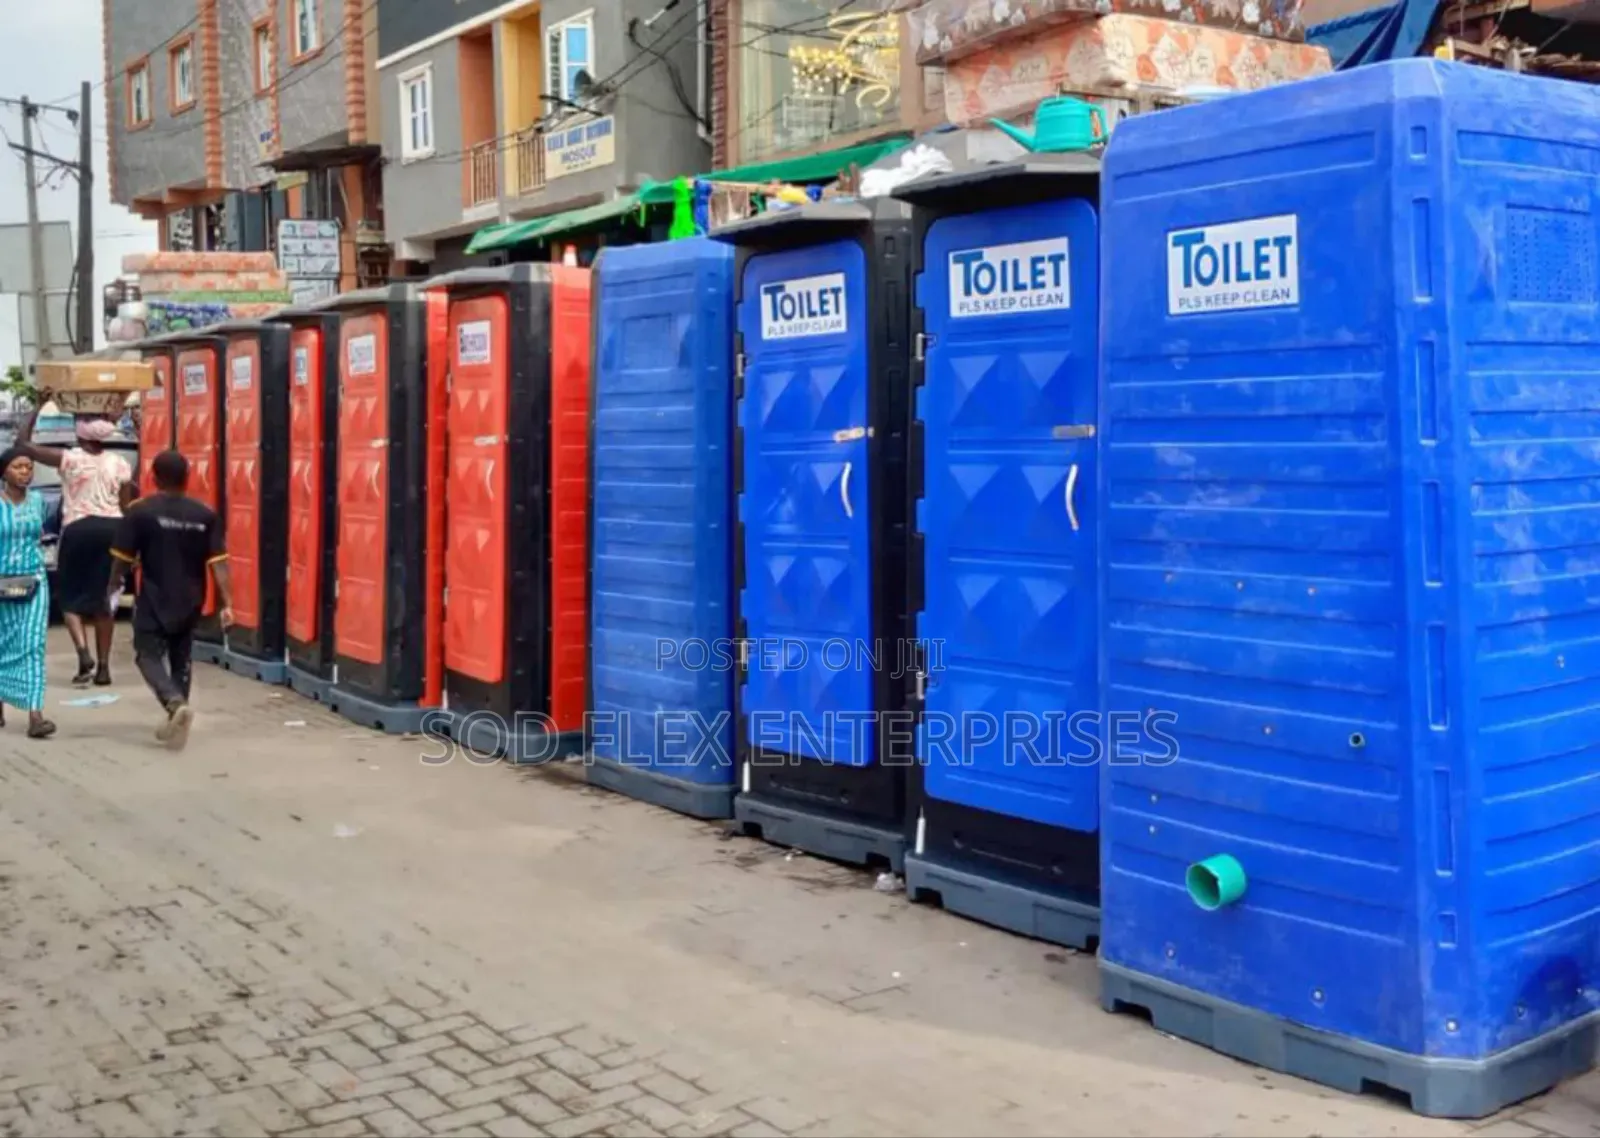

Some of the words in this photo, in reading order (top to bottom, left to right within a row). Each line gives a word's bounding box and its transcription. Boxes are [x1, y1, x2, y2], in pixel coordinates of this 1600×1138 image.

[952, 250, 1066, 297] TOILET
[1172, 231, 1292, 288] TOILET
[763, 284, 842, 322] TOILET
[958, 301, 981, 313] PLS
[983, 297, 1017, 311] KEEP
[1019, 292, 1064, 308] CLEAN
[1178, 296, 1202, 309] PLS
[1205, 292, 1240, 307] KEEP
[1243, 287, 1291, 303] CLEAN
[768, 325, 785, 337] PLS
[787, 322, 810, 334] KEEP
[811, 319, 842, 331] CLEAN
